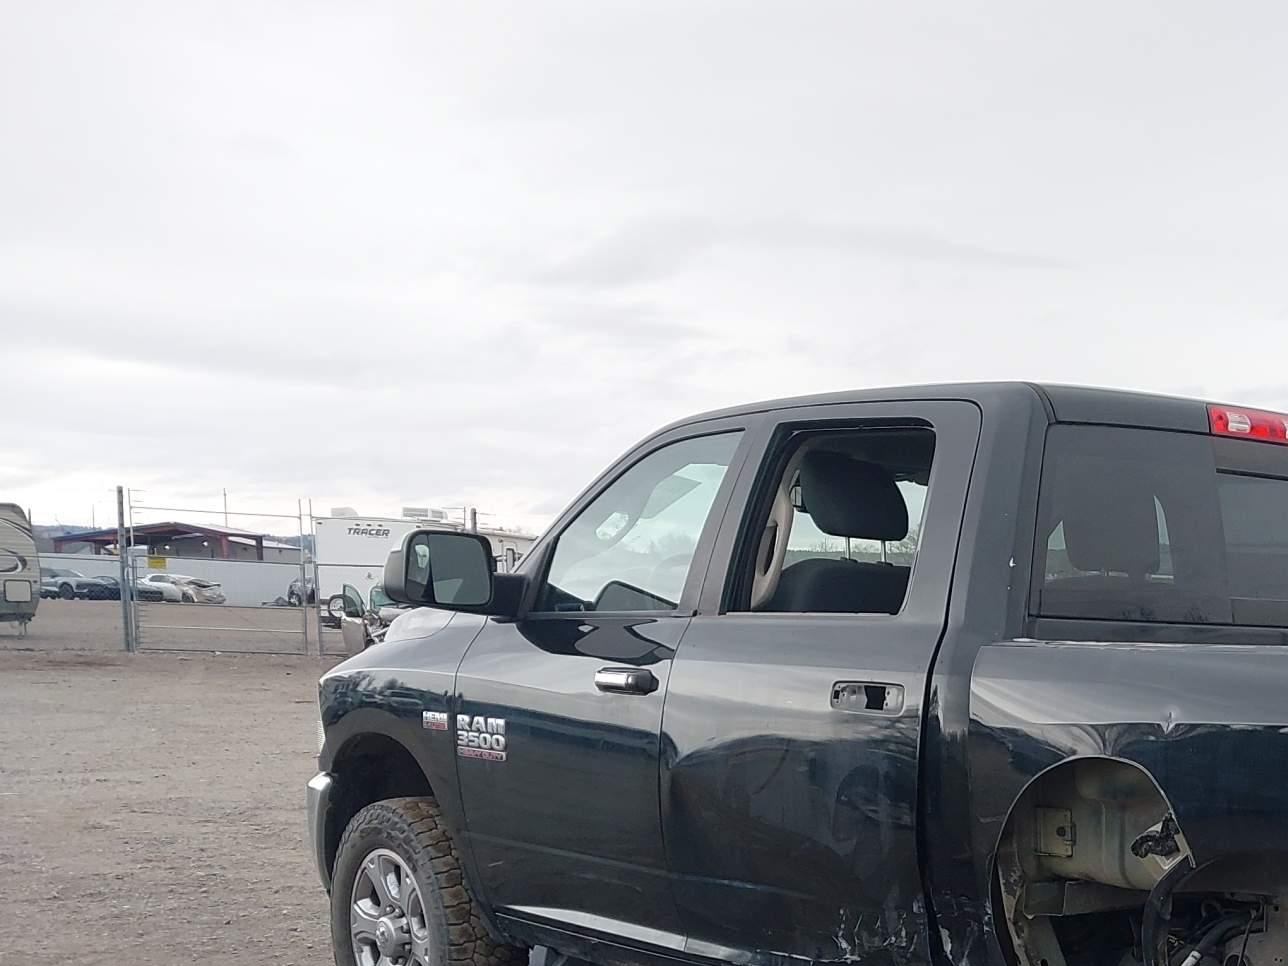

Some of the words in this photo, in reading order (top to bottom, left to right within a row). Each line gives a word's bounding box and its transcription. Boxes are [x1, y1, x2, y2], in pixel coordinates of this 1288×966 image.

[347, 527, 390, 537] TRACER
[457, 714, 505, 734] RAM
[457, 730, 505, 751] 3500
